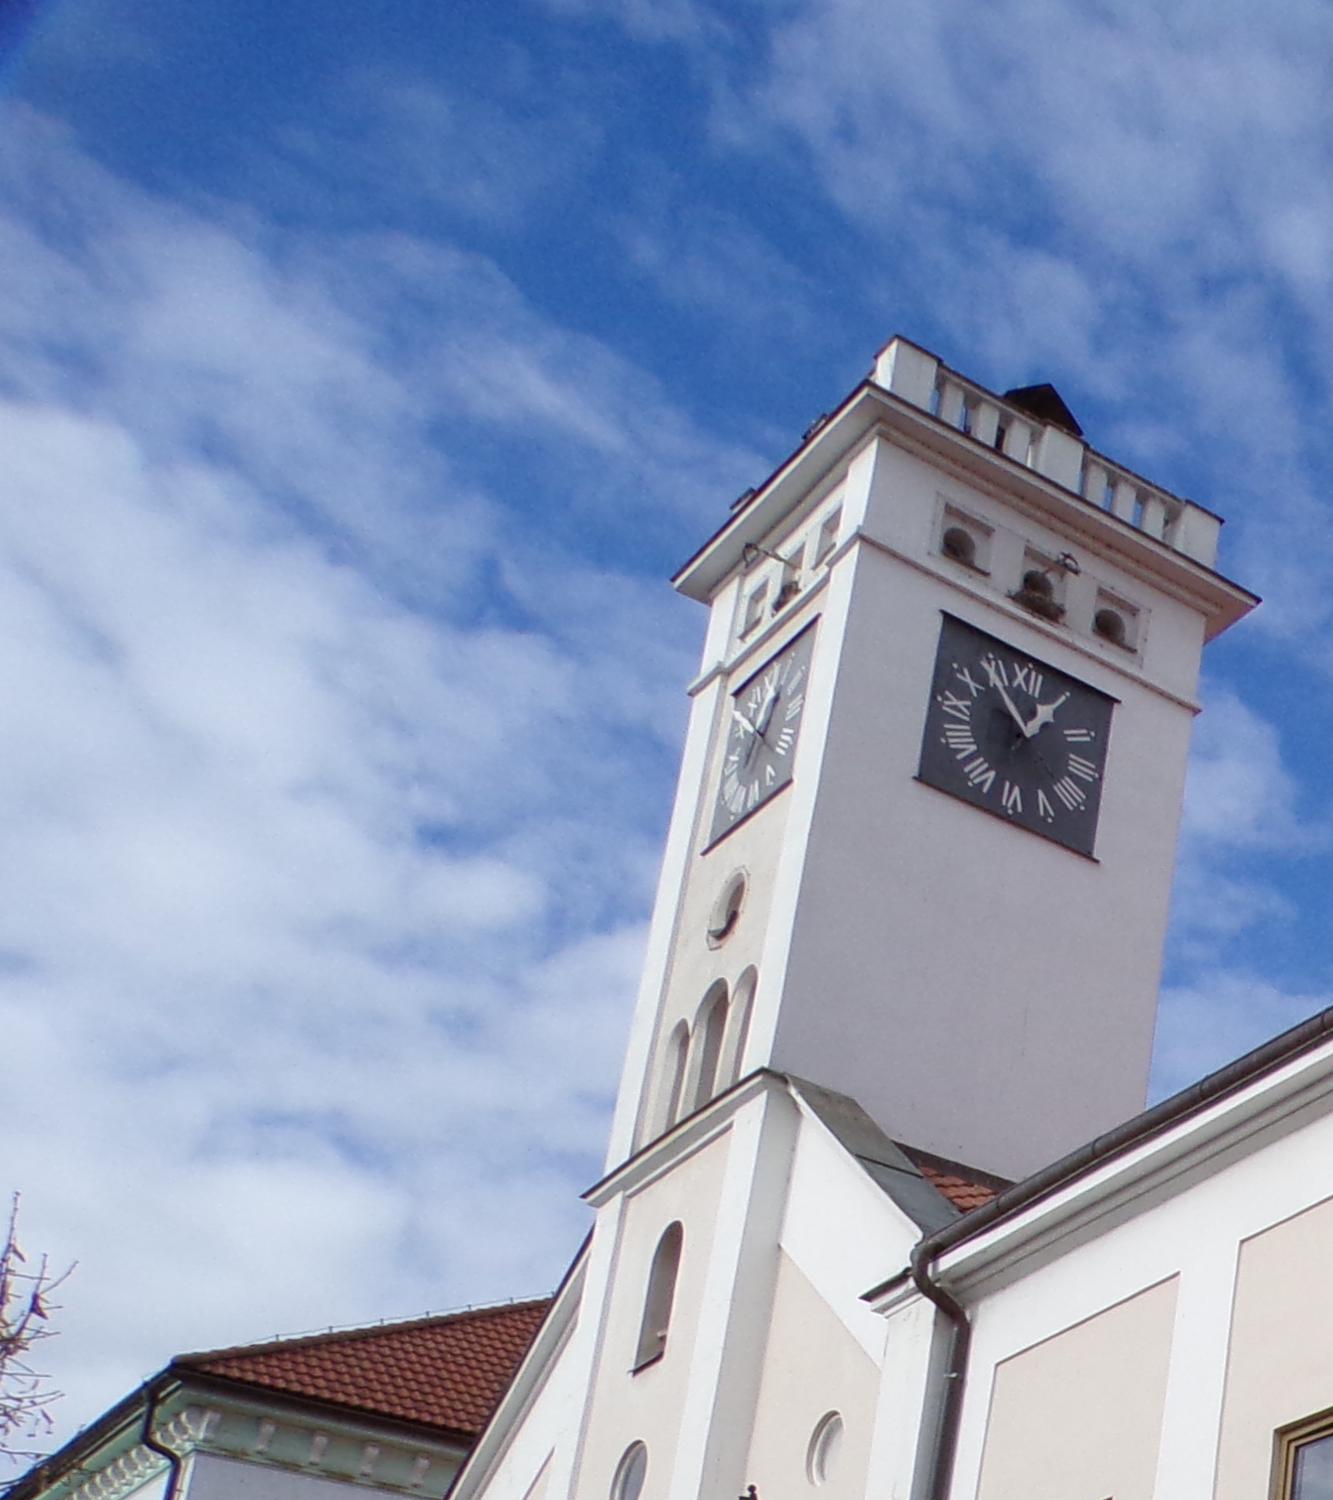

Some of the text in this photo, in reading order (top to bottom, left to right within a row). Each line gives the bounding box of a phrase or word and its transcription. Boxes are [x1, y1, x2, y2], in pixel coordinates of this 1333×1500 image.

[956, 667, 985, 697] X
[1012, 662, 1043, 698] XII
[1063, 729, 1091, 742] II
[964, 757, 996, 793] VII
[1068, 753, 1097, 782] III
[1002, 780, 1022, 812] VI
[1038, 789, 1054, 817] V
